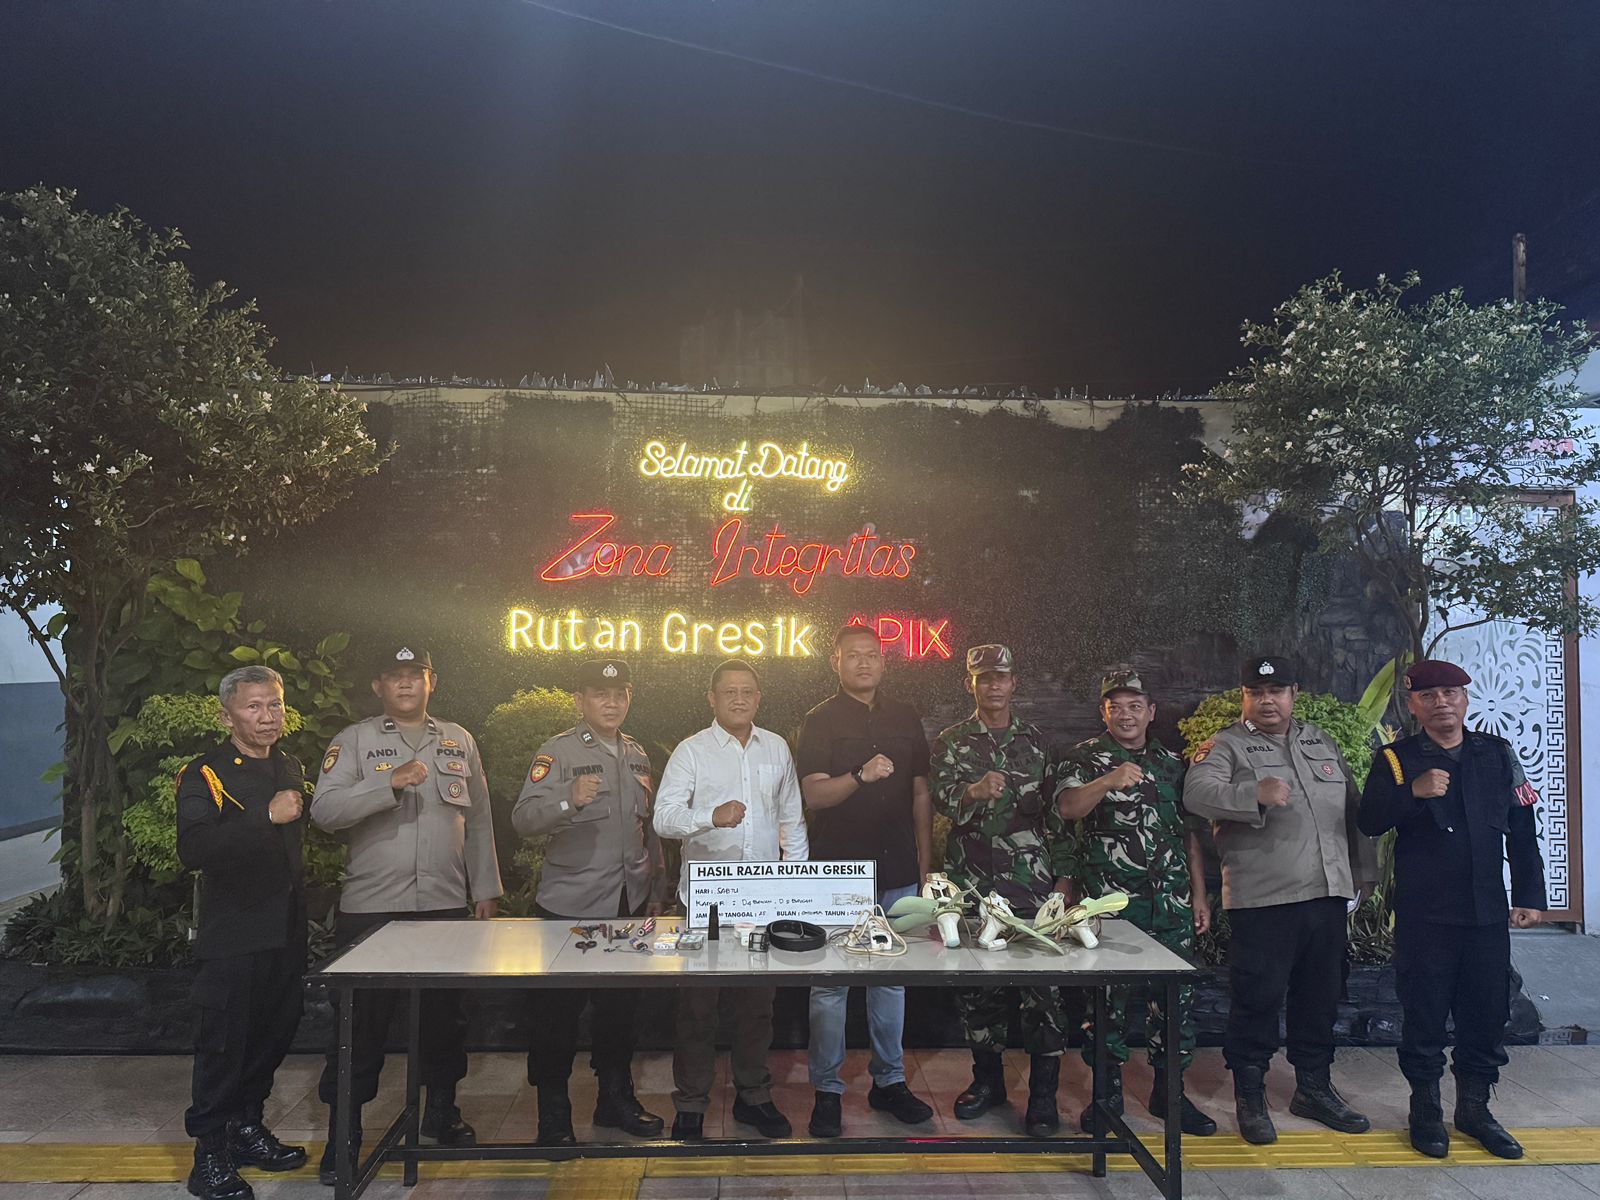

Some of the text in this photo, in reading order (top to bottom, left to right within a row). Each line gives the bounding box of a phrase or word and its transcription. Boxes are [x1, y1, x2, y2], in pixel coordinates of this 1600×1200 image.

[641, 441, 848, 491] Selamat Datang
[724, 481, 750, 511] di
[541, 514, 915, 594] Zona Integritas
[509, 609, 951, 658] Rutan Gresik PIK
[366, 748, 398, 760] ANDI
[436, 748, 466, 759] POLRI
[697, 864, 866, 877] HASIL RAZIA RUTAN GRESIK
